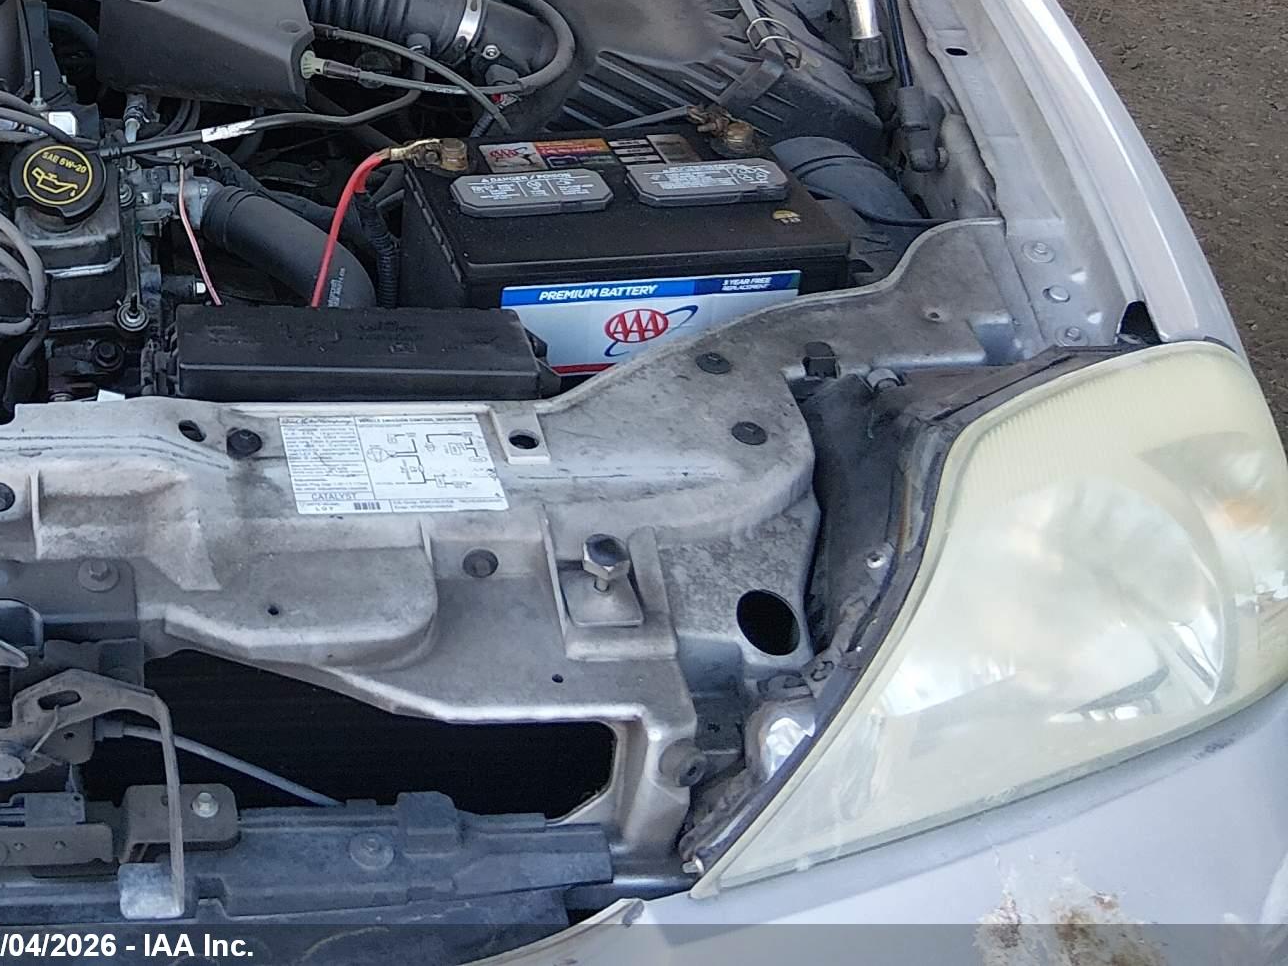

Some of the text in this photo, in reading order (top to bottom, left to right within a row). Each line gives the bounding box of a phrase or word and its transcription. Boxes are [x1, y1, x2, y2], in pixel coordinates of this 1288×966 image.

[41, 151, 60, 164] SAE
[490, 175, 529, 183] DANGER
[535, 172, 572, 180] POISON
[729, 278, 751, 286] YEAR
[751, 276, 772, 284] FREE
[539, 284, 659, 301] PREMIUM BATTERY
[607, 310, 667, 342] AAA
[312, 491, 357, 501] CATALYST
